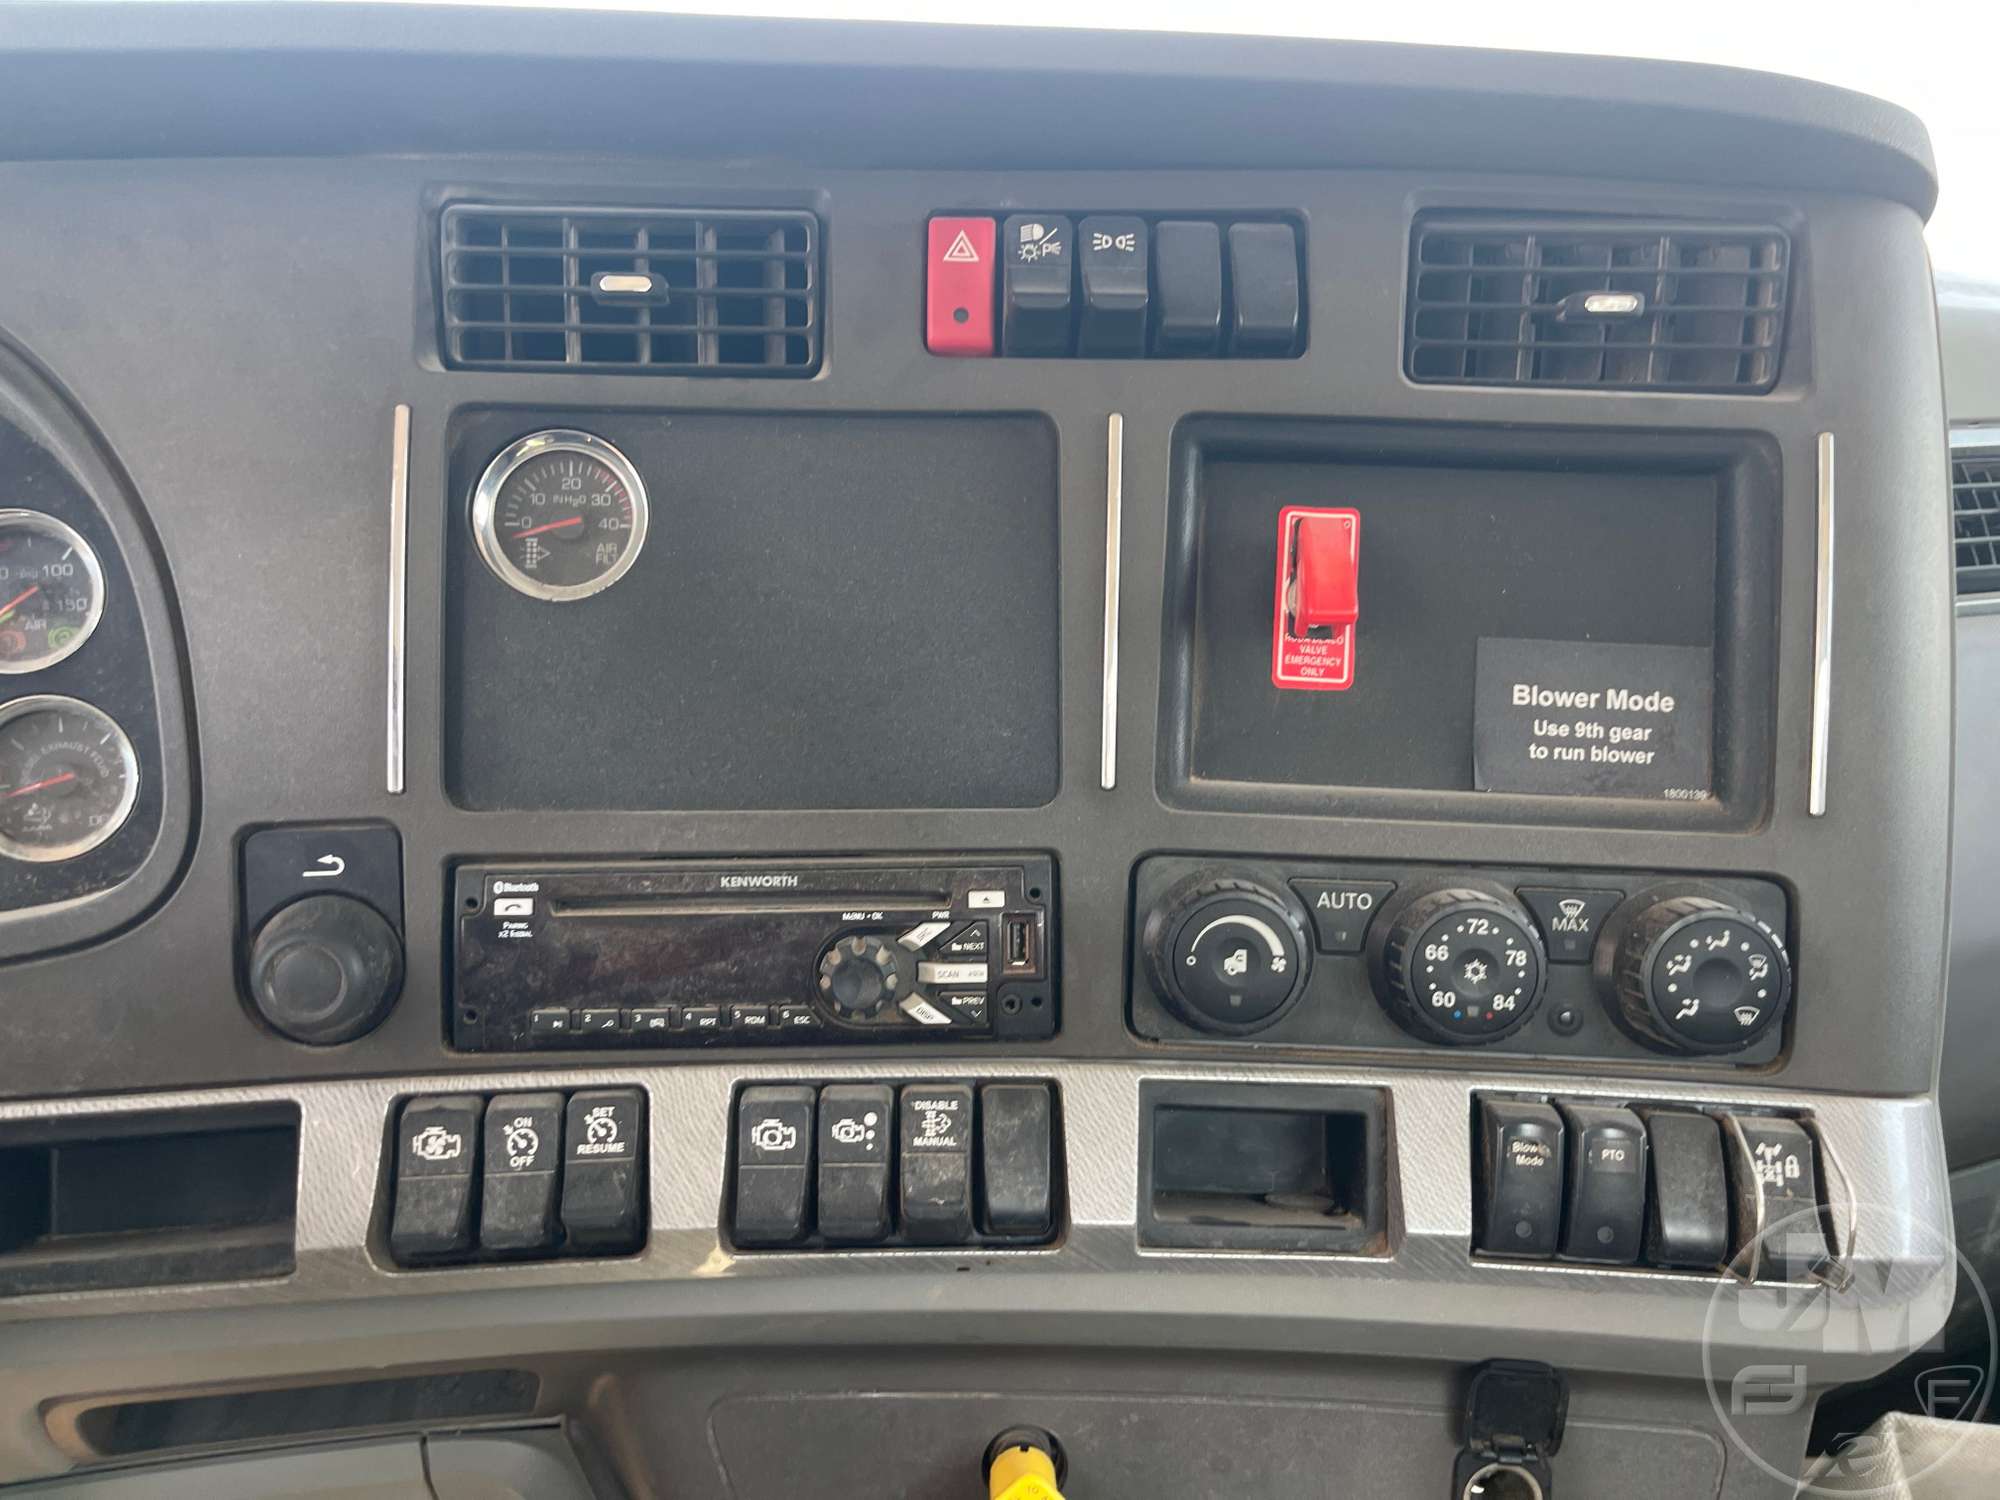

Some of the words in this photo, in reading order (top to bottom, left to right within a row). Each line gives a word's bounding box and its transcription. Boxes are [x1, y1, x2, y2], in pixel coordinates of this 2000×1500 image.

[562, 478, 581, 490] 20
[530, 493, 546, 506] 10
[592, 494, 611, 506] 30
[521, 516, 531, 528] 0
[599, 518, 619, 530] 40
[42, 563, 74, 577] 100
[57, 598, 88, 611] 150
[25, 619, 47, 631] AIR
[1300, 645, 1327, 655] VALVE
[1285, 655, 1341, 666] EMERGENCY
[1301, 667, 1325, 676] ONLY
[1512, 684, 1600, 709] Blower
[1606, 689, 1675, 712] Mode
[1533, 720, 1570, 737] Use
[1575, 721, 1604, 739] 9th
[1609, 726, 1652, 743] gear
[1529, 743, 1548, 760] to
[1553, 747, 1584, 761] run
[1590, 746, 1654, 765] blower
[720, 875, 798, 888] KENWORTH
[1317, 892, 1372, 910] AUTO
[871, 911, 884, 920] OK
[932, 910, 950, 919] PWR
[1466, 918, 1489, 935] 72
[1551, 918, 1590, 932] MAX
[962, 942, 985, 951] NEXT
[1424, 943, 1449, 961] 66
[1505, 949, 1527, 967] 78
[937, 970, 960, 979] SCAN
[962, 996, 985, 1006] PREV
[1431, 990, 1456, 1008] 60
[1492, 993, 1516, 1011] 84
[584, 1013, 592, 1023] 2
[634, 1013, 642, 1023] 3
[685, 1012, 693, 1021] 4
[734, 1010, 742, 1020] 5
[782, 1009, 790, 1019] 6
[593, 1106, 616, 1117] SET
[914, 1100, 959, 1111] DISABLE
[513, 1116, 533, 1128] ON
[912, 1136, 958, 1147] MANUAL
[576, 1141, 625, 1155] RESUME
[1515, 1153, 1545, 1167] Mode
[1601, 1149, 1625, 1162] PTO
[509, 1156, 535, 1168] OFF
